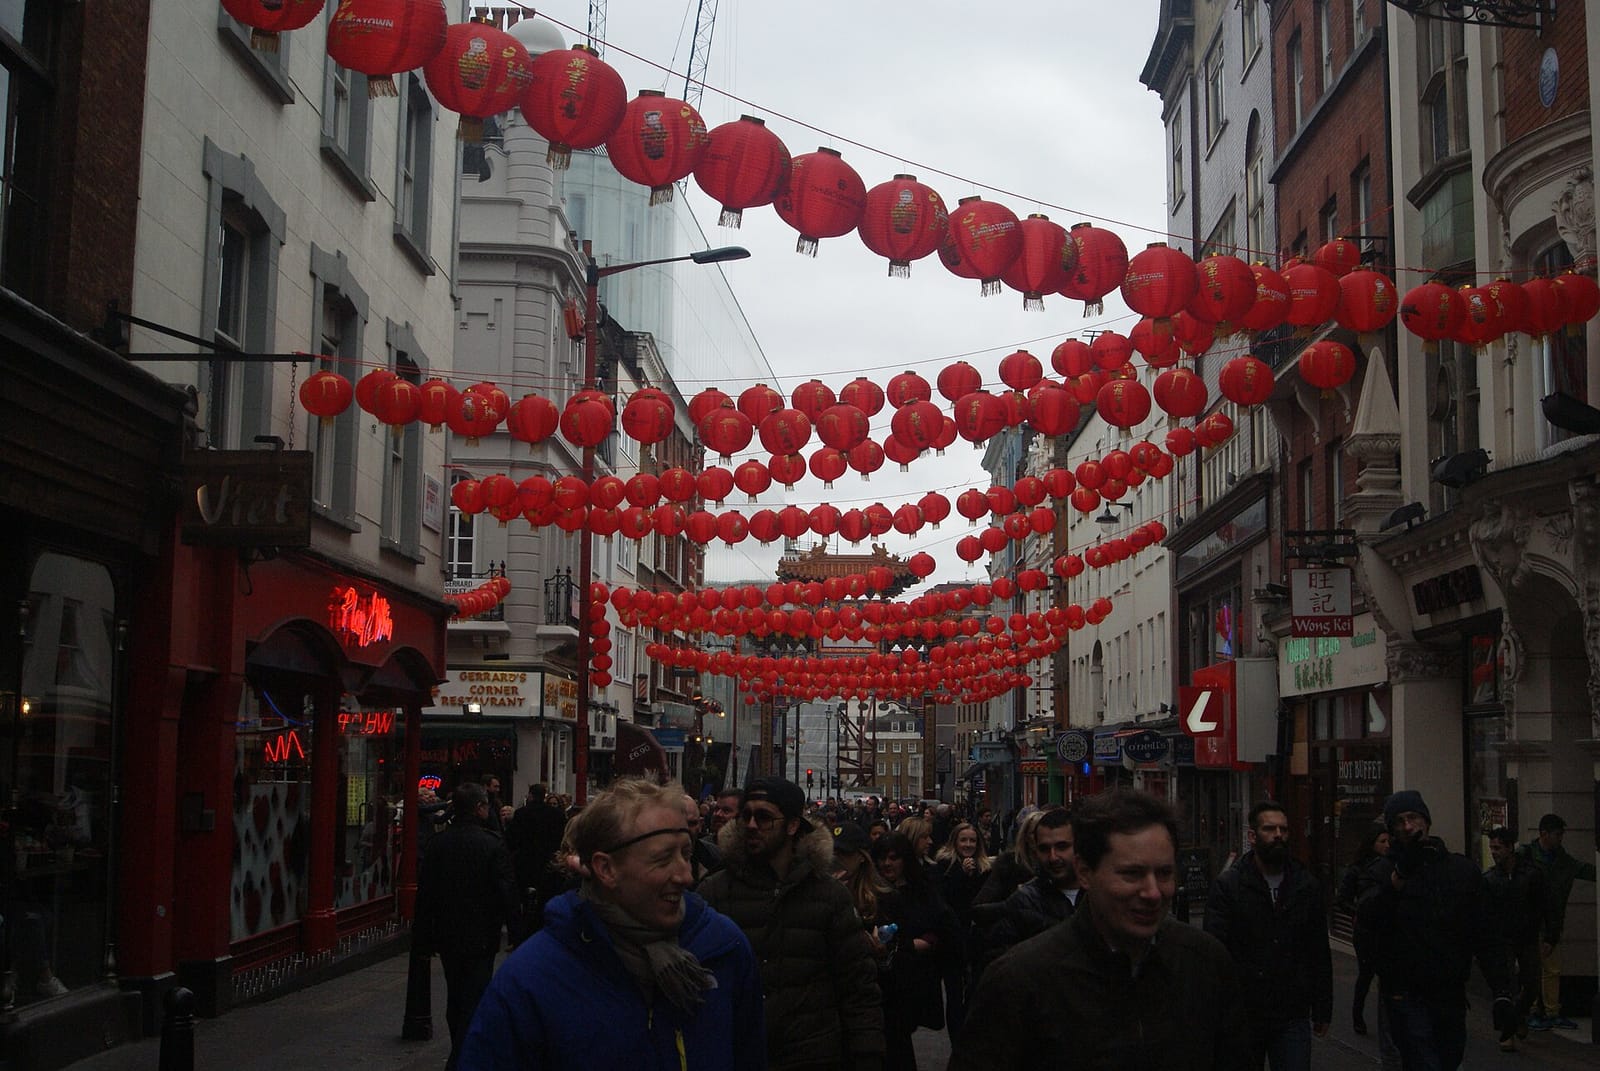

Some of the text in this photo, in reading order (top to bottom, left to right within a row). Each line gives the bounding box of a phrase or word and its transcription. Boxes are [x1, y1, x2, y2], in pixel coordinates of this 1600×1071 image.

[1308, 571, 1336, 613] 旺記
[1294, 618, 1351, 635] Wong Kei
[459, 671, 528, 683] GERRARD'S
[469, 685, 519, 696] CORNER
[440, 696, 526, 707] RESTAURANT
[628, 744, 651, 761] £6.90
[1338, 759, 1383, 780] HOT BUFFET
[418, 777, 442, 789] PEN
